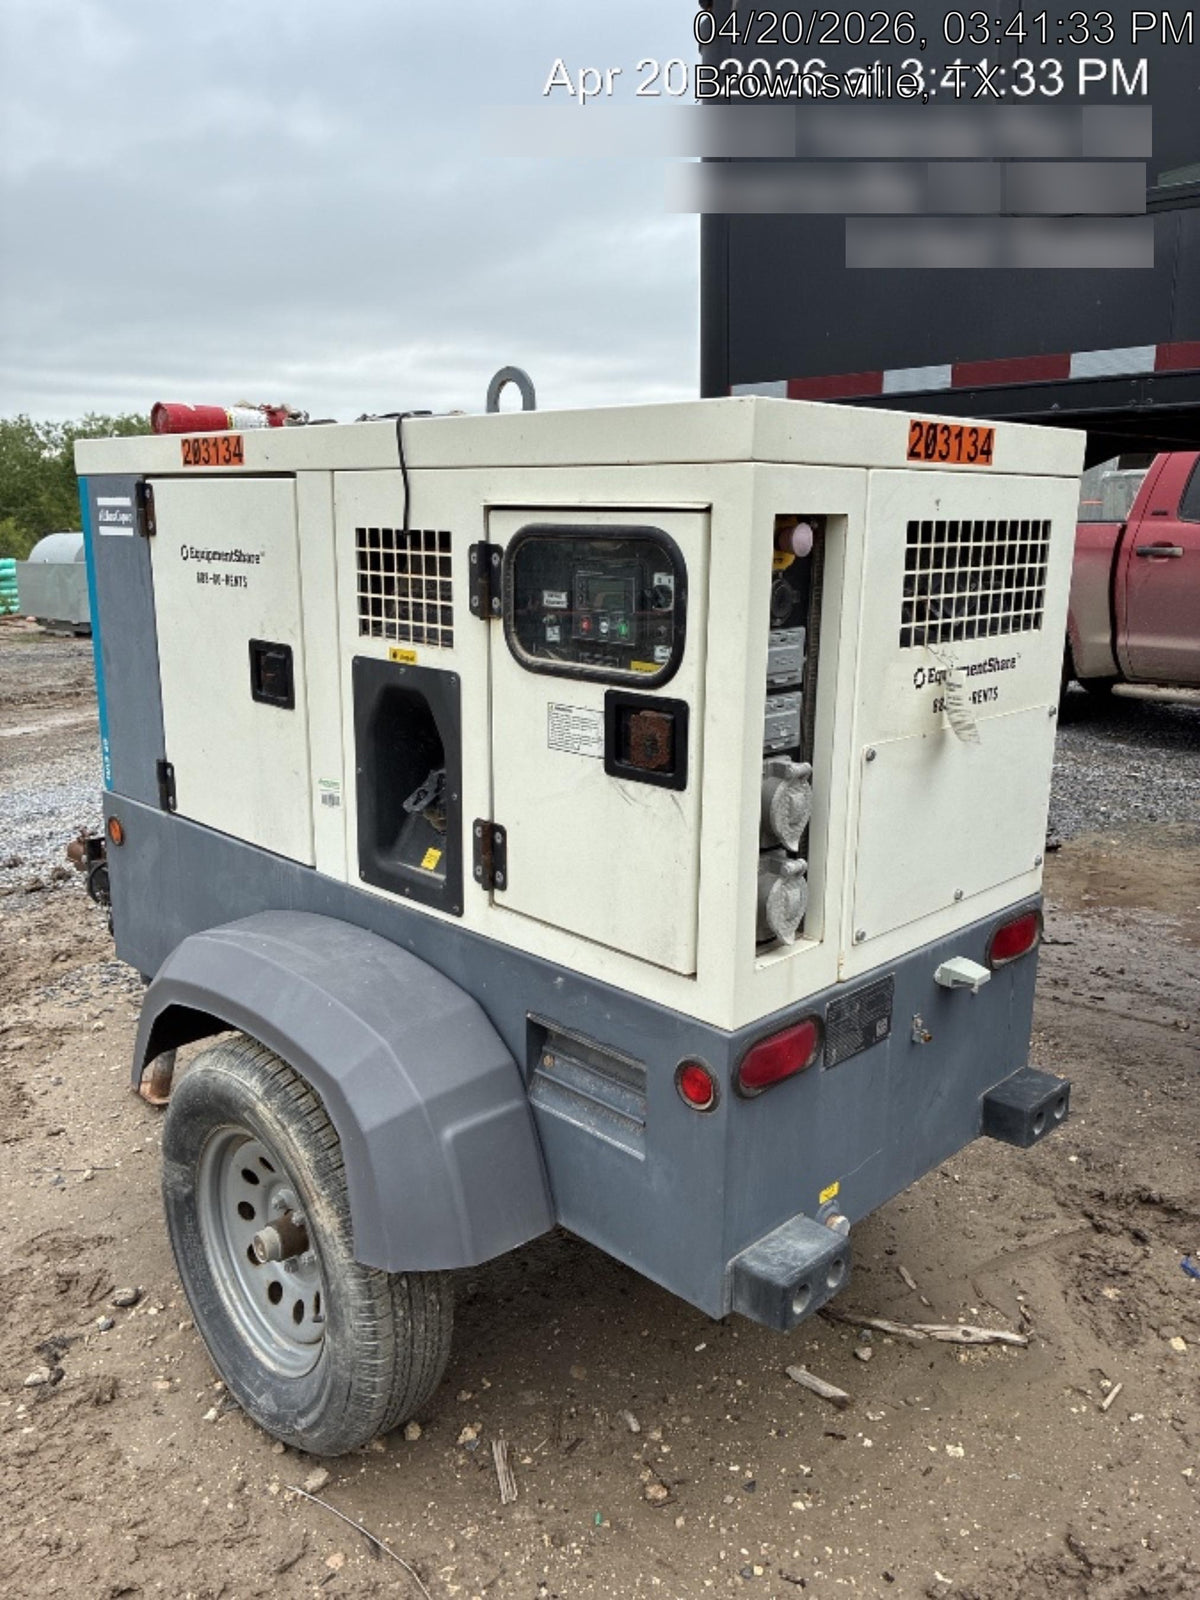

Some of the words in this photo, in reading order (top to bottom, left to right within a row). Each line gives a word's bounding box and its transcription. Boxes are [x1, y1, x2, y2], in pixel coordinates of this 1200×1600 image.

[182, 435, 244, 465] 203134
[908, 421, 994, 463] 203134
[190, 546, 260, 565] EquipmentShare
